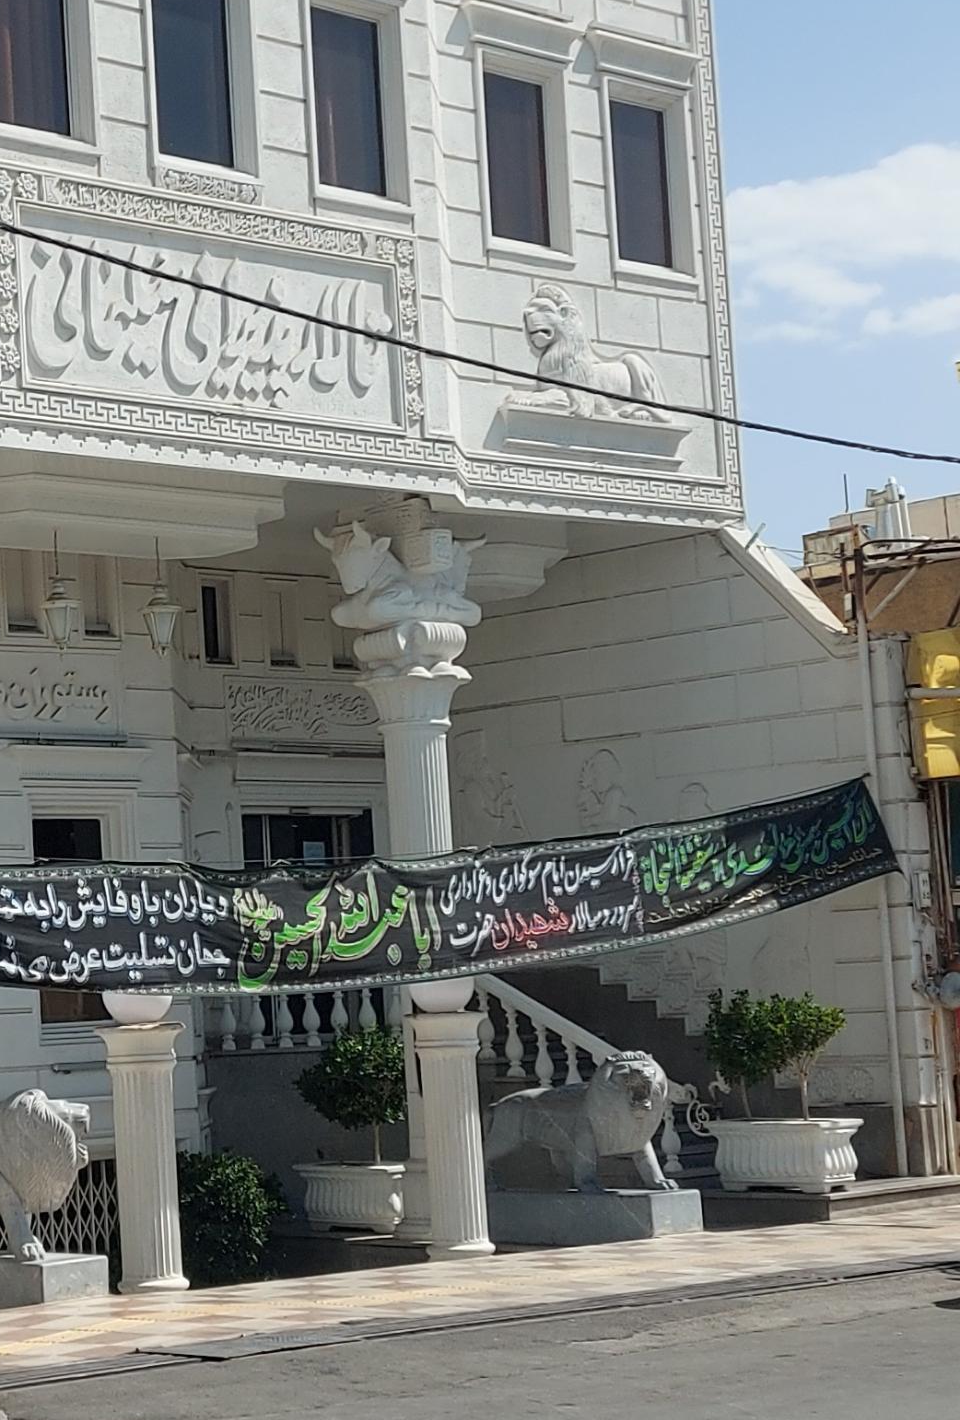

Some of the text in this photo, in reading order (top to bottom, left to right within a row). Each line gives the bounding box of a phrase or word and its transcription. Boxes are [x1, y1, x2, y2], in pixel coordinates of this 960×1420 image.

[286, 279, 393, 399] تالار
[3, 667, 111, 724] رستوران
[49, 938, 104, 985] عرض
[102, 931, 177, 981] تسلیت
